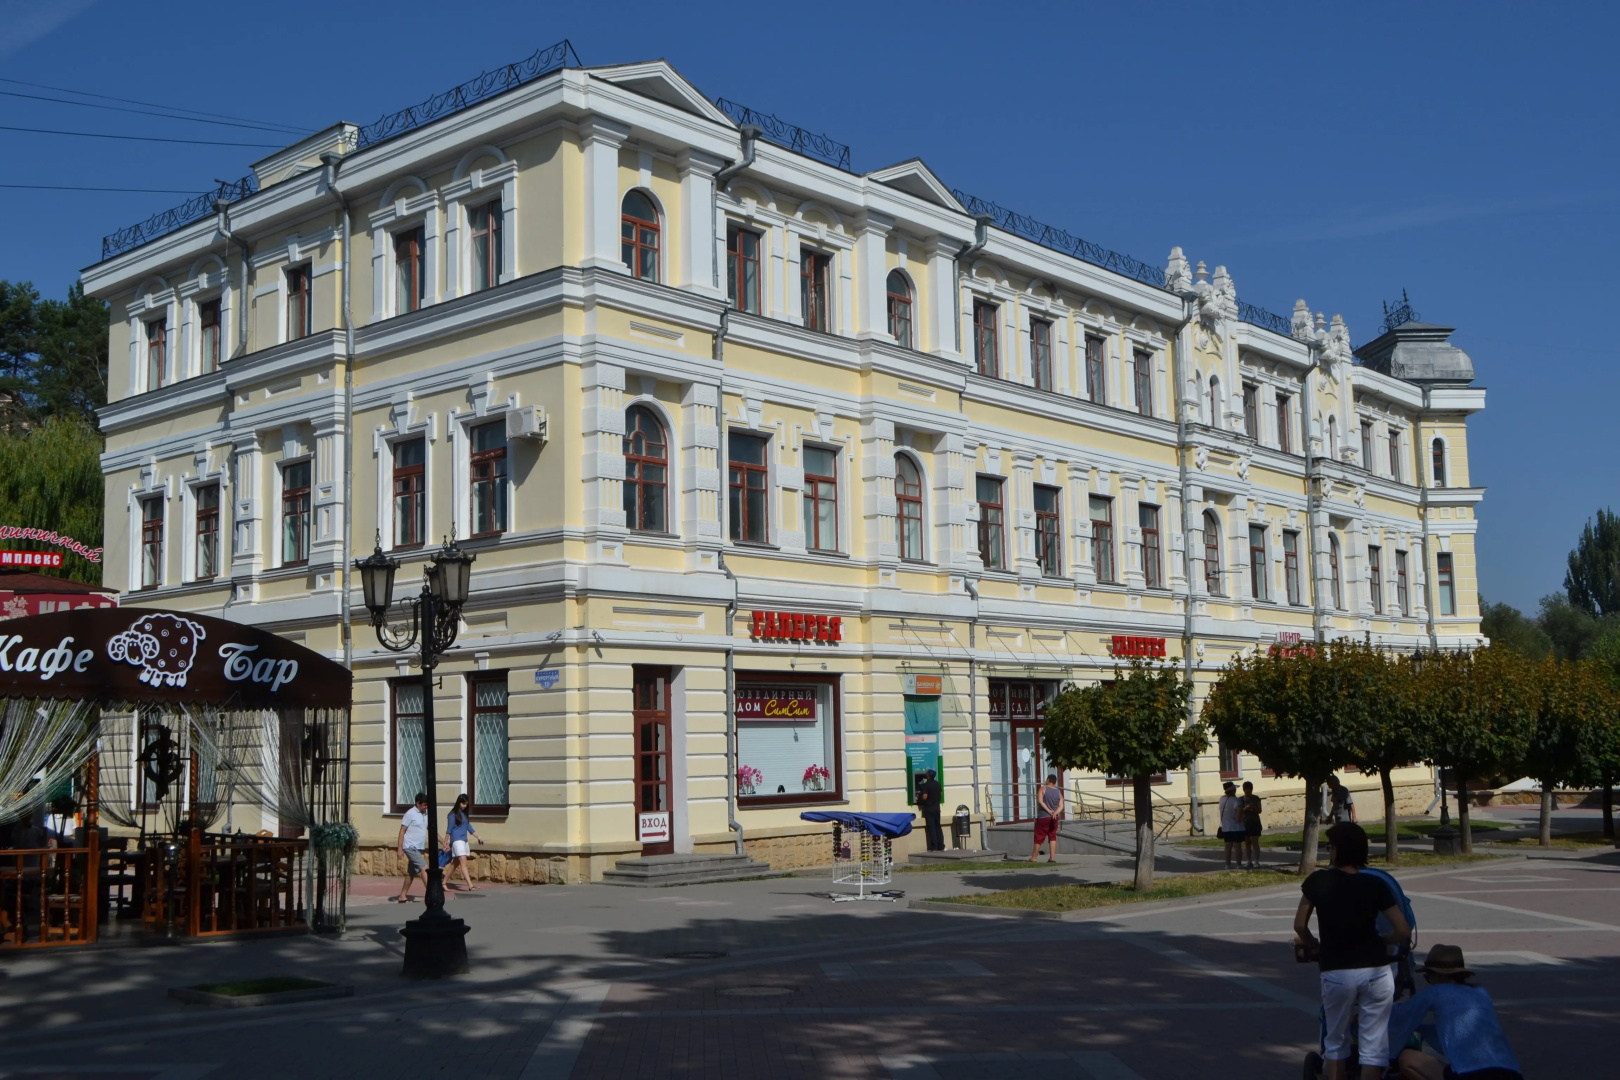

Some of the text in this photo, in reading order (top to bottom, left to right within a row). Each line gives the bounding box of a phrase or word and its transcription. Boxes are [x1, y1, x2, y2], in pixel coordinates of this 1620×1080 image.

[752, 610, 842, 641] ГАЛЕРЕЯ
[1280, 631, 1301, 643] ЦЕНТР
[1112, 636, 1166, 656] ГАЛЕРЕЯ
[0, 634, 299, 692] Кафе Бар
[736, 689, 812, 700] ЮВЕЛИРНЫЙ
[737, 702, 761, 712] ДОМ
[641, 817, 667, 829] ВХОД
